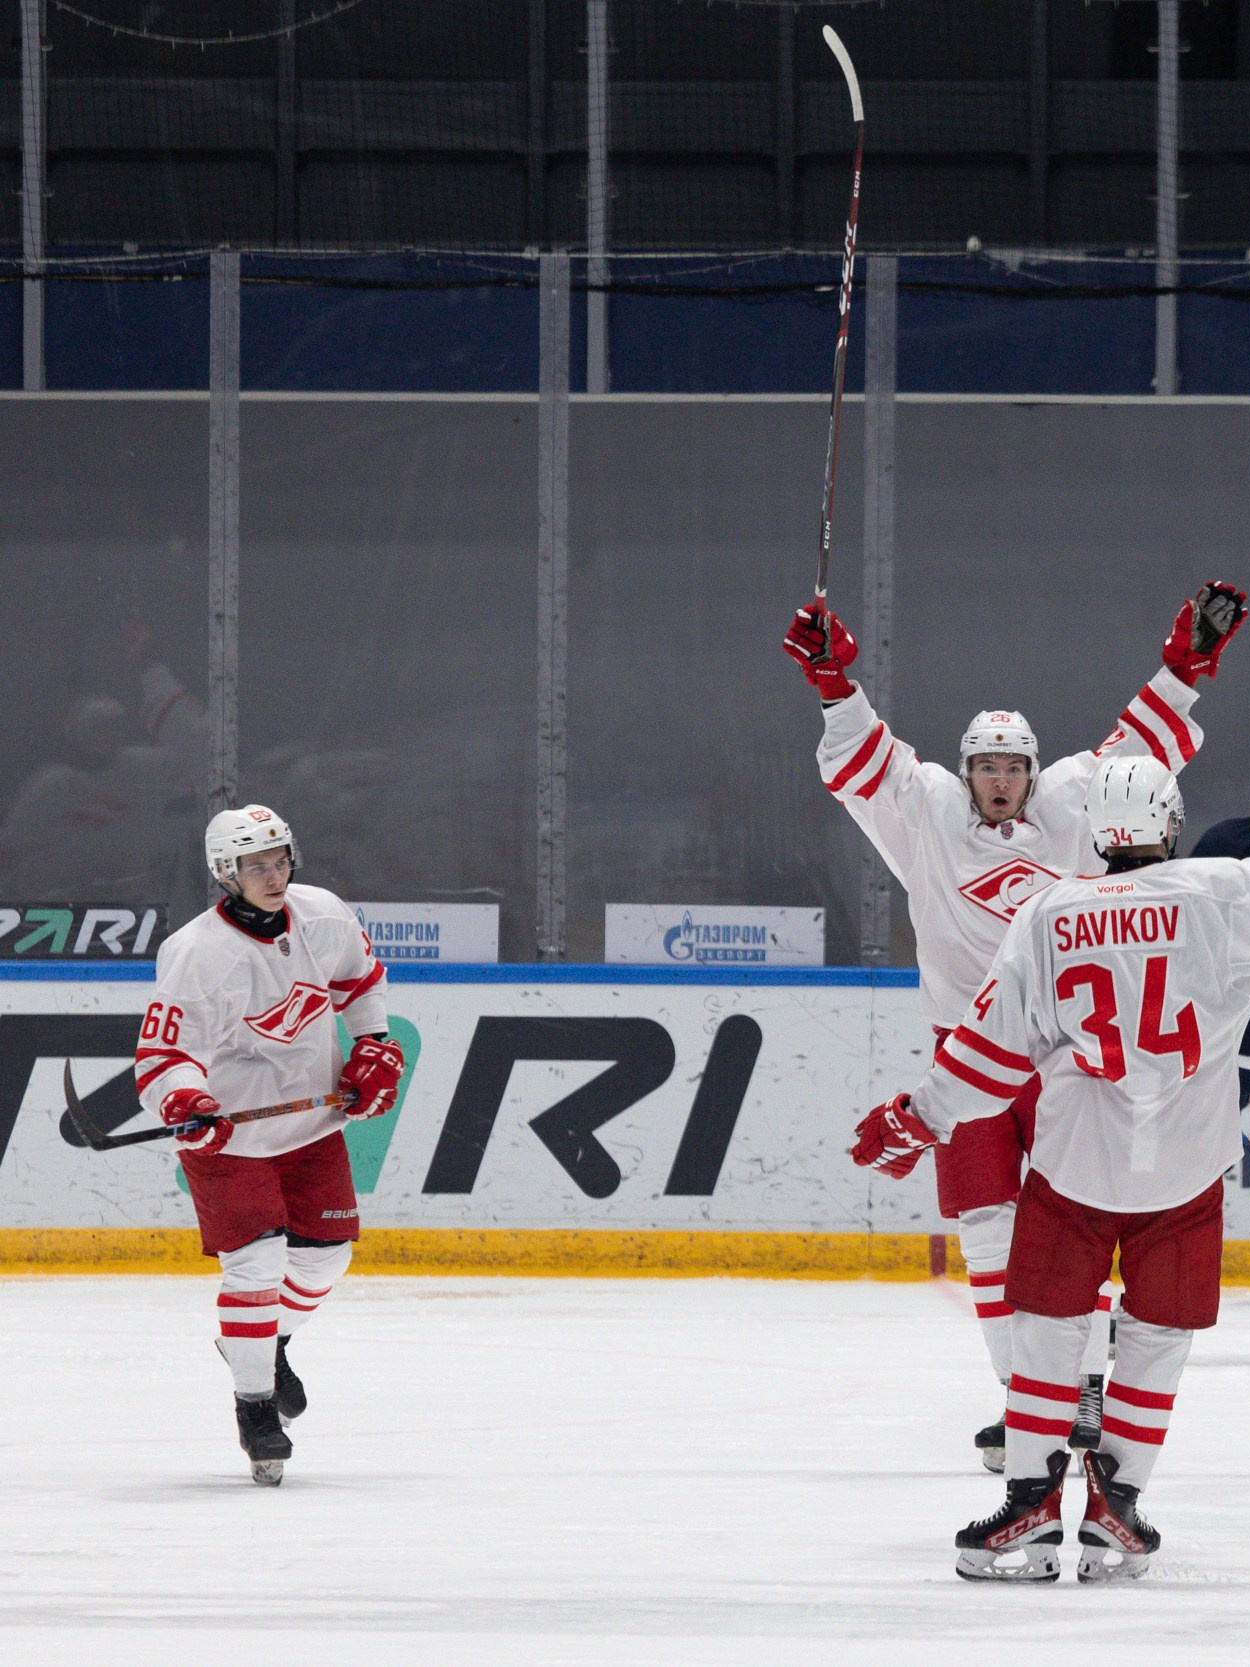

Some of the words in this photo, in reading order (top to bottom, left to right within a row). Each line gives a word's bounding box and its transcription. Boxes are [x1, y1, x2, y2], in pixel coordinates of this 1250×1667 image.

[990, 713, 1011, 723] 26
[1105, 827, 1133, 846] 34
[1096, 884, 1134, 894] Vorgol
[368, 922, 440, 942] ГАЗПРОМ
[695, 923, 767, 945] ГАЗПРОМ
[1054, 906, 1180, 952] SAVIKOV
[140, 1001, 184, 1046] 66
[1055, 955, 1202, 1084] 34
[990, 1508, 1049, 1549] CCM
[1099, 1511, 1146, 1553] CCM
